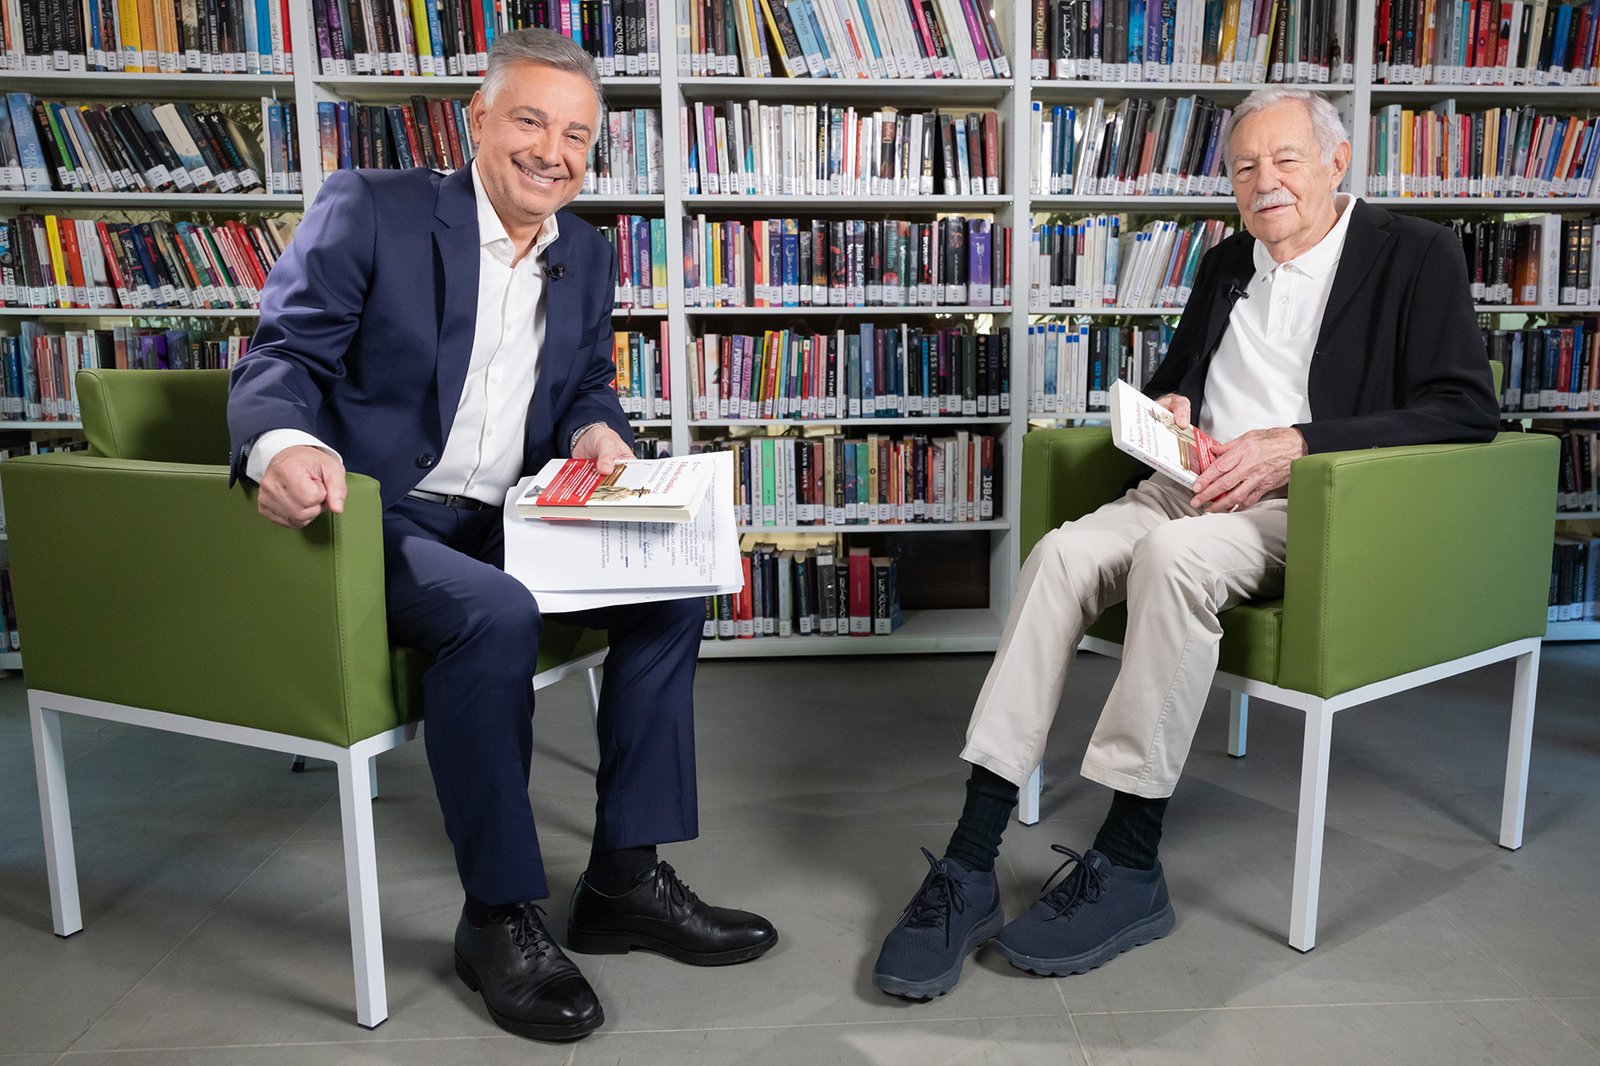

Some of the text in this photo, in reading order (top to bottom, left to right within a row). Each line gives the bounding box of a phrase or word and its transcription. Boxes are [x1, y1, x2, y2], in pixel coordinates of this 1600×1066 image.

[561, 3, 570, 29] SAVE US
[572, 3, 581, 30] SAVE ME
[1034, 7, 1046, 51] MURTAGH
[615, 15, 624, 54] OSCUROS
[629, 17, 637, 49] OSCUROS
[815, 231, 825, 265] Dorado
[732, 348, 742, 381] PERFECTO
[983, 475, 993, 501] 1984
[878, 579, 888, 618] ERAGO
